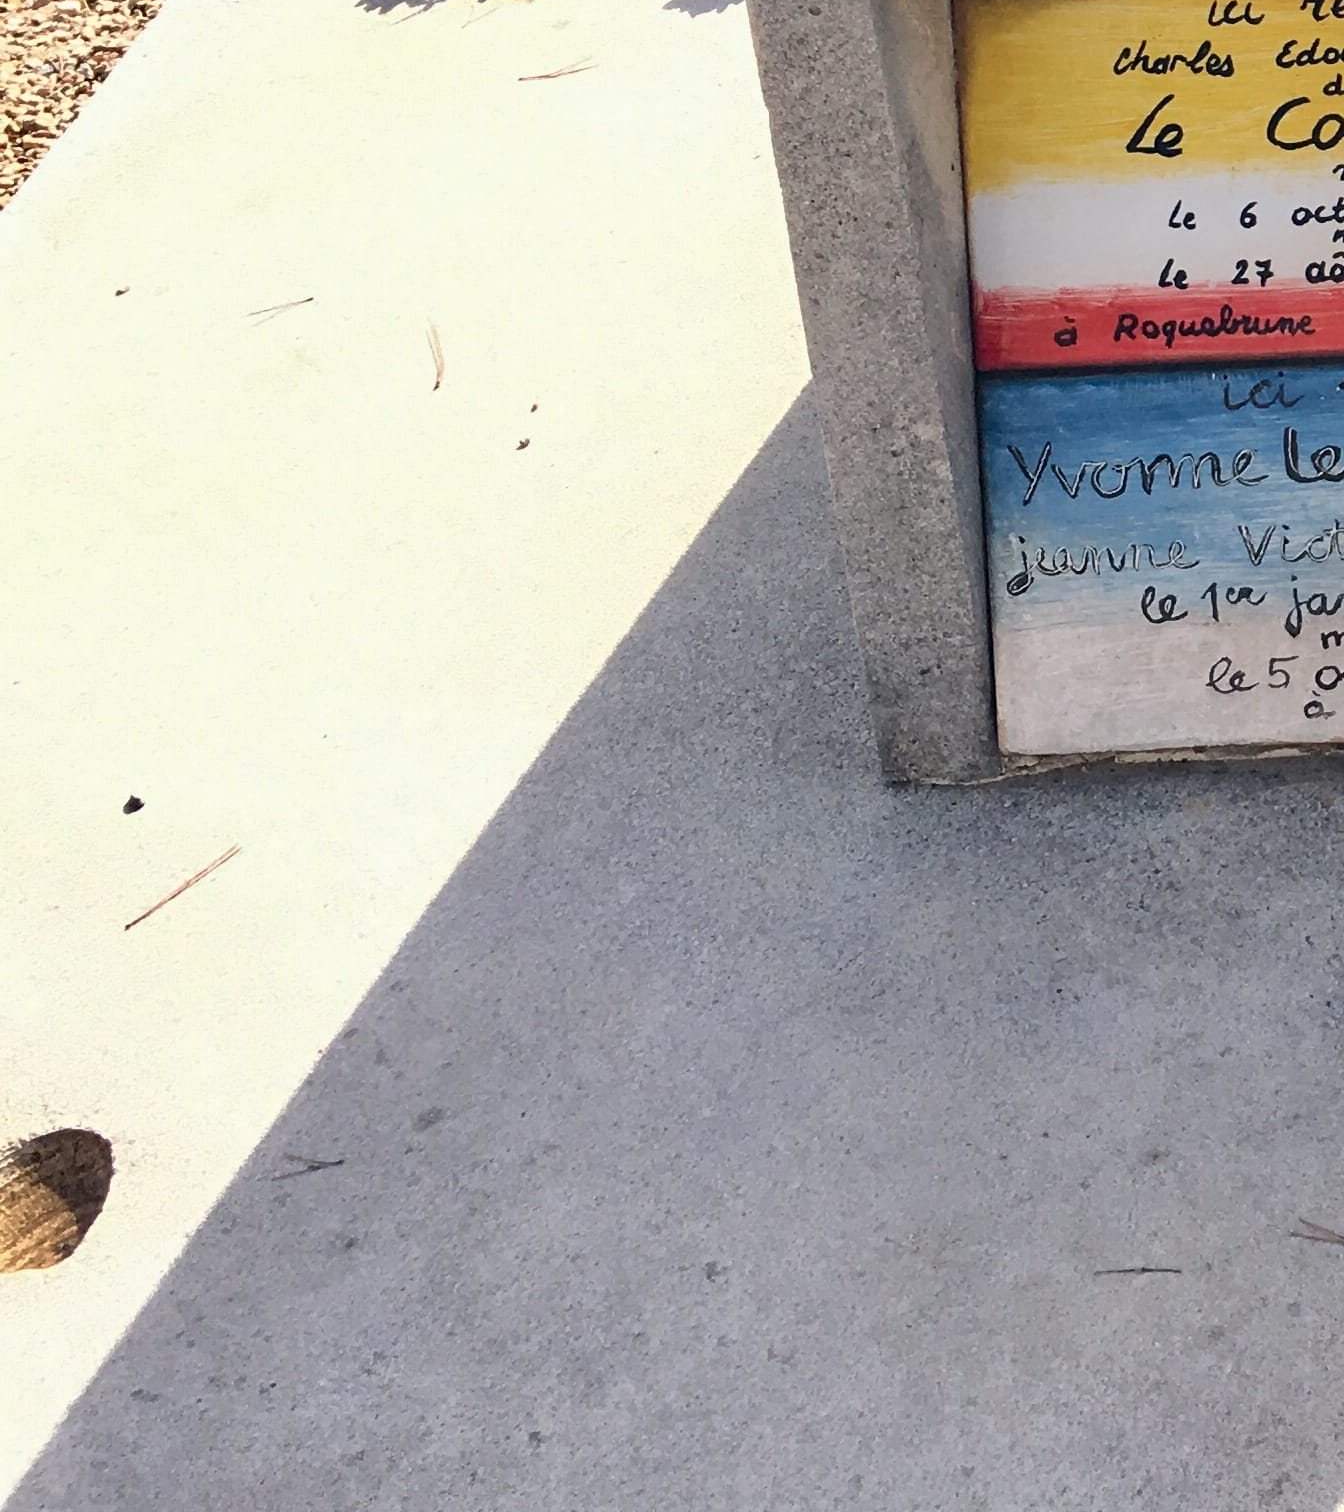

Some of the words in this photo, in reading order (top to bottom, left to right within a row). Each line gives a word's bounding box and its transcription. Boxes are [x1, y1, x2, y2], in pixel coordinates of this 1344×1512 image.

[1125, 94, 1184, 158] Le
[1239, 201, 1258, 229] 6
[1231, 258, 1275, 288] 27
[1053, 315, 1078, 347] à
[1221, 371, 1303, 410] ici
[1008, 441, 1270, 505] Yvonne
[1140, 585, 1189, 624] le
[1206, 656, 1259, 694] le
[1268, 655, 1301, 689] 5
[1302, 691, 1335, 720] à
